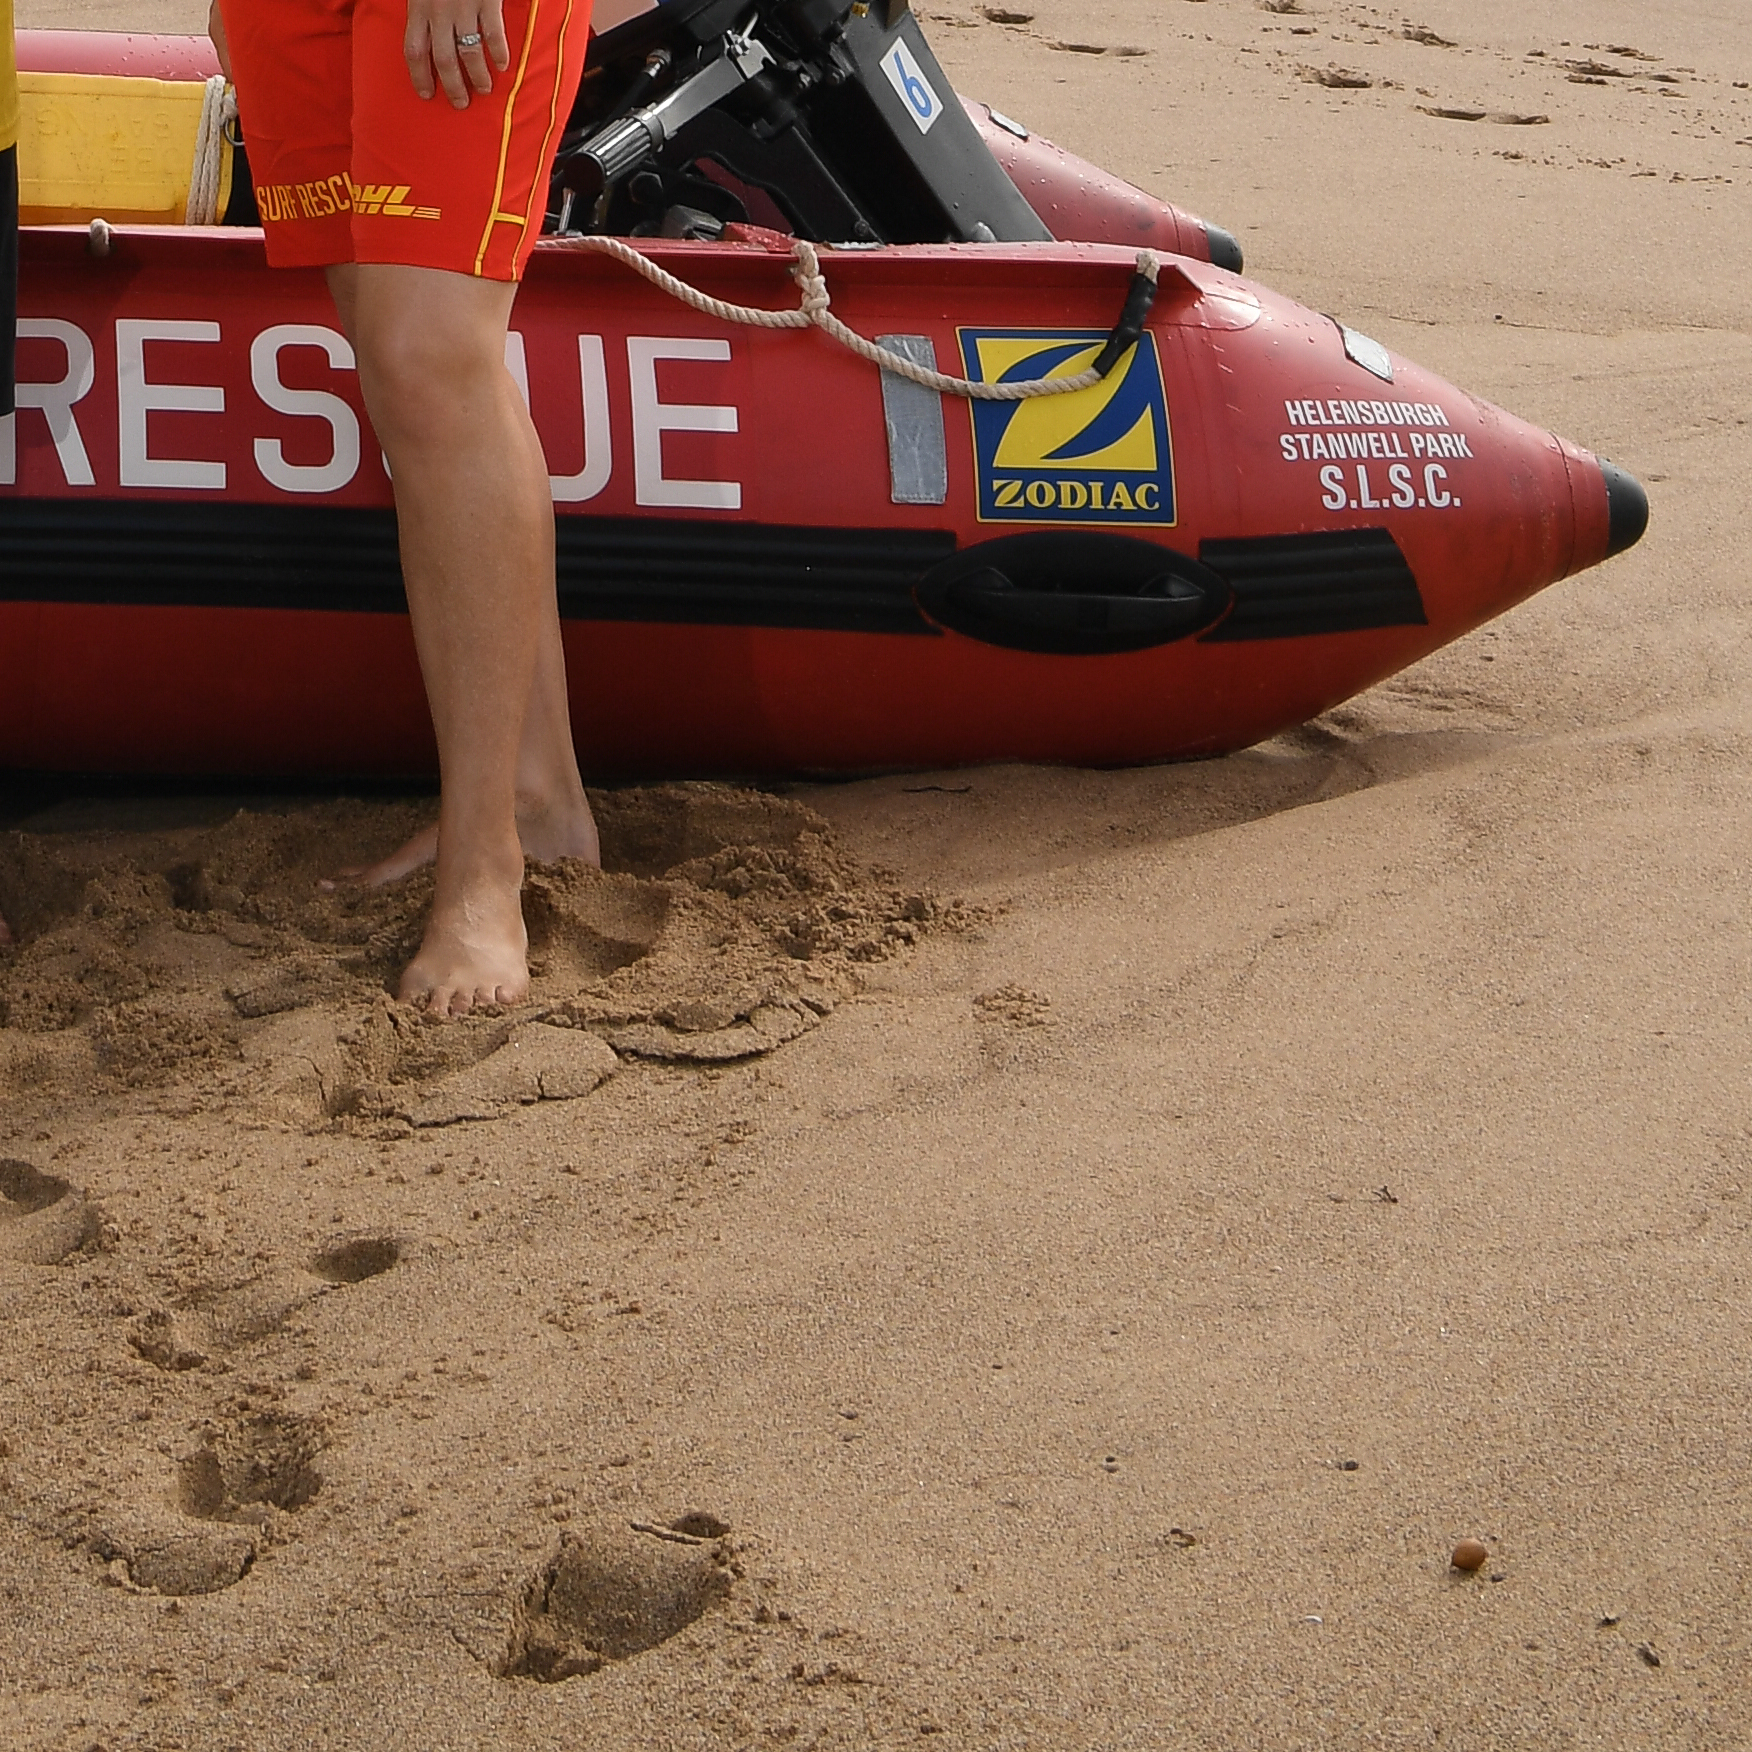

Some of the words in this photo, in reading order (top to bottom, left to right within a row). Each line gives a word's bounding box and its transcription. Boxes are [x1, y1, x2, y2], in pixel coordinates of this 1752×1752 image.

[256, 185, 298, 222] SURF
[1284, 399, 1450, 427] HELENSBURGH
[1279, 432, 1409, 462] STANWELL
[1408, 432, 1474, 459] PARK
[992, 479, 1160, 511] ZODIAC
[1319, 462, 1462, 511] S.L.S.C.
